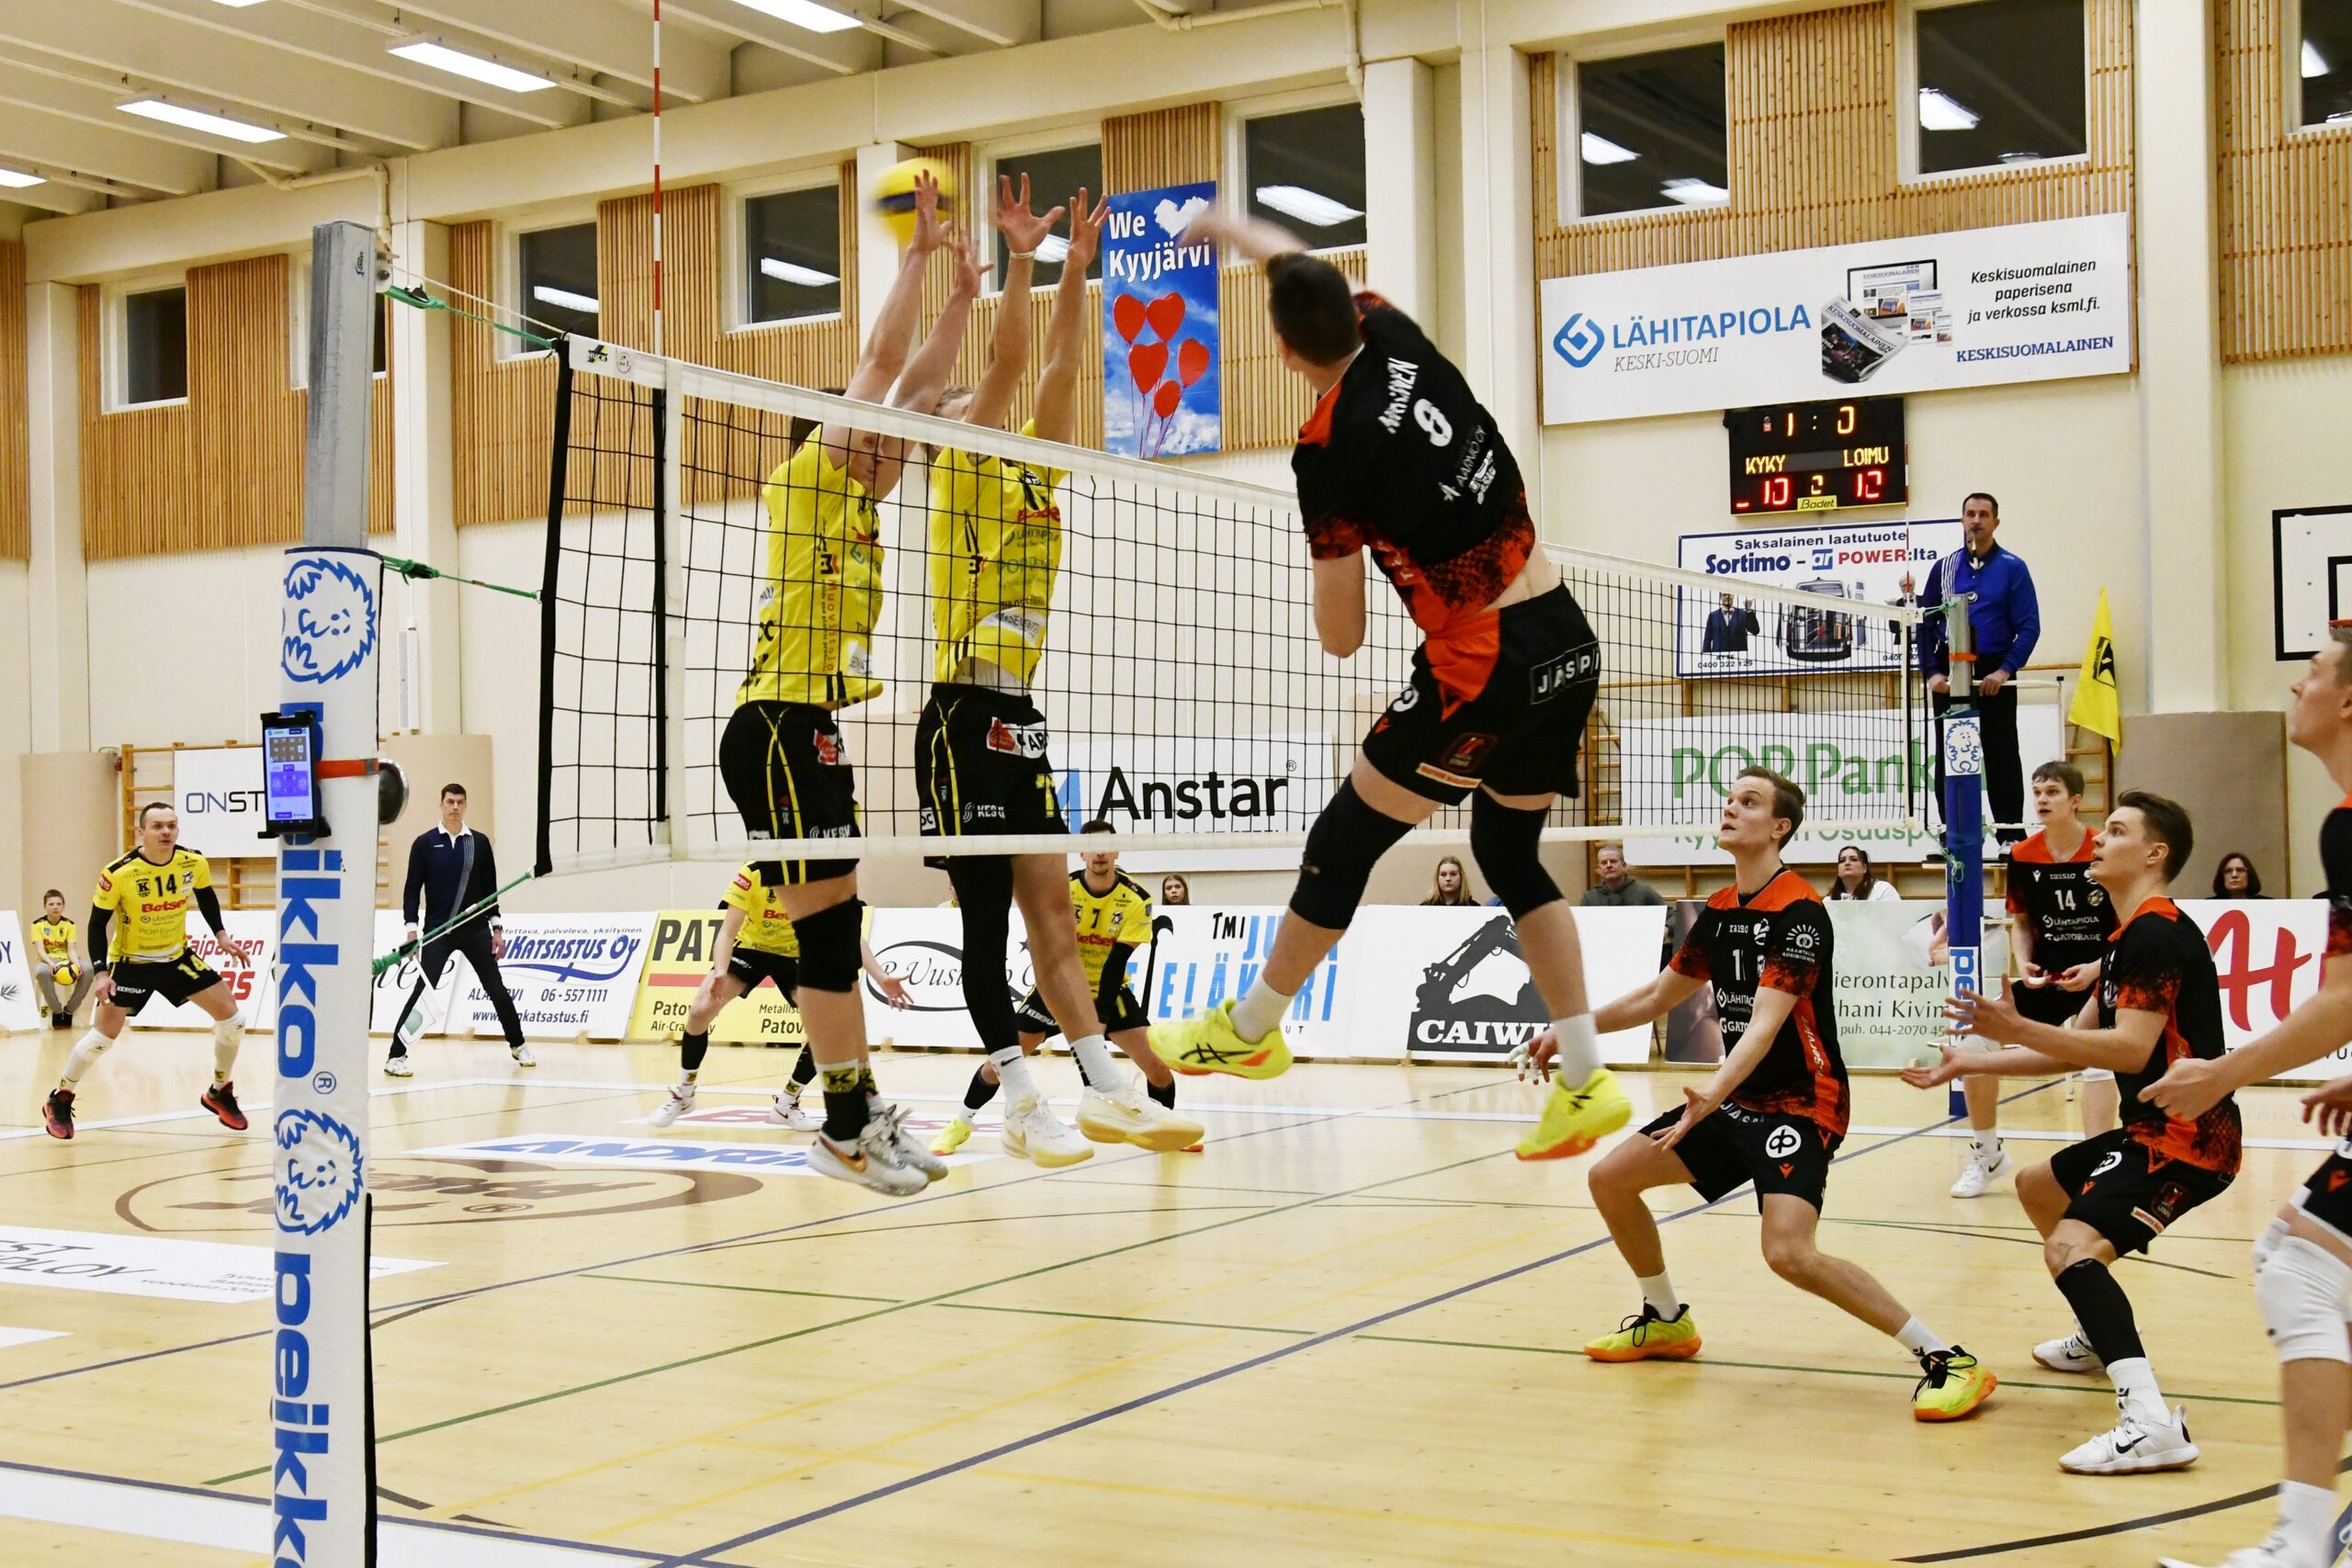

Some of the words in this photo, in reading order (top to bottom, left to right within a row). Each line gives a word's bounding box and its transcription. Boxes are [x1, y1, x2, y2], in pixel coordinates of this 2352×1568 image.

[1109, 210, 1146, 240] We
[1109, 236, 1210, 283] Kyyjärvi
[1971, 261, 2097, 284] Keskisuomalainen
[1995, 283, 2073, 302] paperisena
[1967, 310, 1981, 324] ja
[1985, 304, 2046, 320] verkossa
[2051, 297, 2100, 314] ksml.fi.
[1612, 304, 1811, 349] LÄHITAPIOLA
[1826, 305, 1894, 353] KESKISUOMALAINEN
[1614, 346, 1720, 372] KESKI-SUOMI
[1956, 336, 2114, 363] KESKISUOMALAINEN
[1746, 454, 1786, 475] KYKY
[1843, 446, 1890, 468] LOIMU
[1811, 475, 1824, 495] 2
[1857, 470, 1883, 499] 12
[1800, 499, 1836, 509] Bodet
[1735, 535, 1824, 550] Saksalainen
[1829, 531, 1907, 546] laatutuote
[1705, 551, 1791, 574] Sortimo
[1096, 766, 1288, 820] Anstar
[154, 874, 177, 897] 14
[2054, 889, 2076, 911] 14
[543, 927, 590, 935] palveleva,
[593, 927, 645, 935] yksityinen.
[1091, 908, 1101, 930] 7
[1212, 911, 1246, 940] TMI
[0, 941, 12, 964] Y
[468, 987, 524, 1002] ALARVI
[540, 987, 557, 1002] 06
[1158, 953, 1338, 1021] ELÄKRI
[471, 1009, 589, 1024] www.nkatsastus.fi
[1840, 1024, 1866, 1038] puh.
[1869, 1023, 1928, 1036] 044-2070
[274, 1251, 329, 1568] peikk
